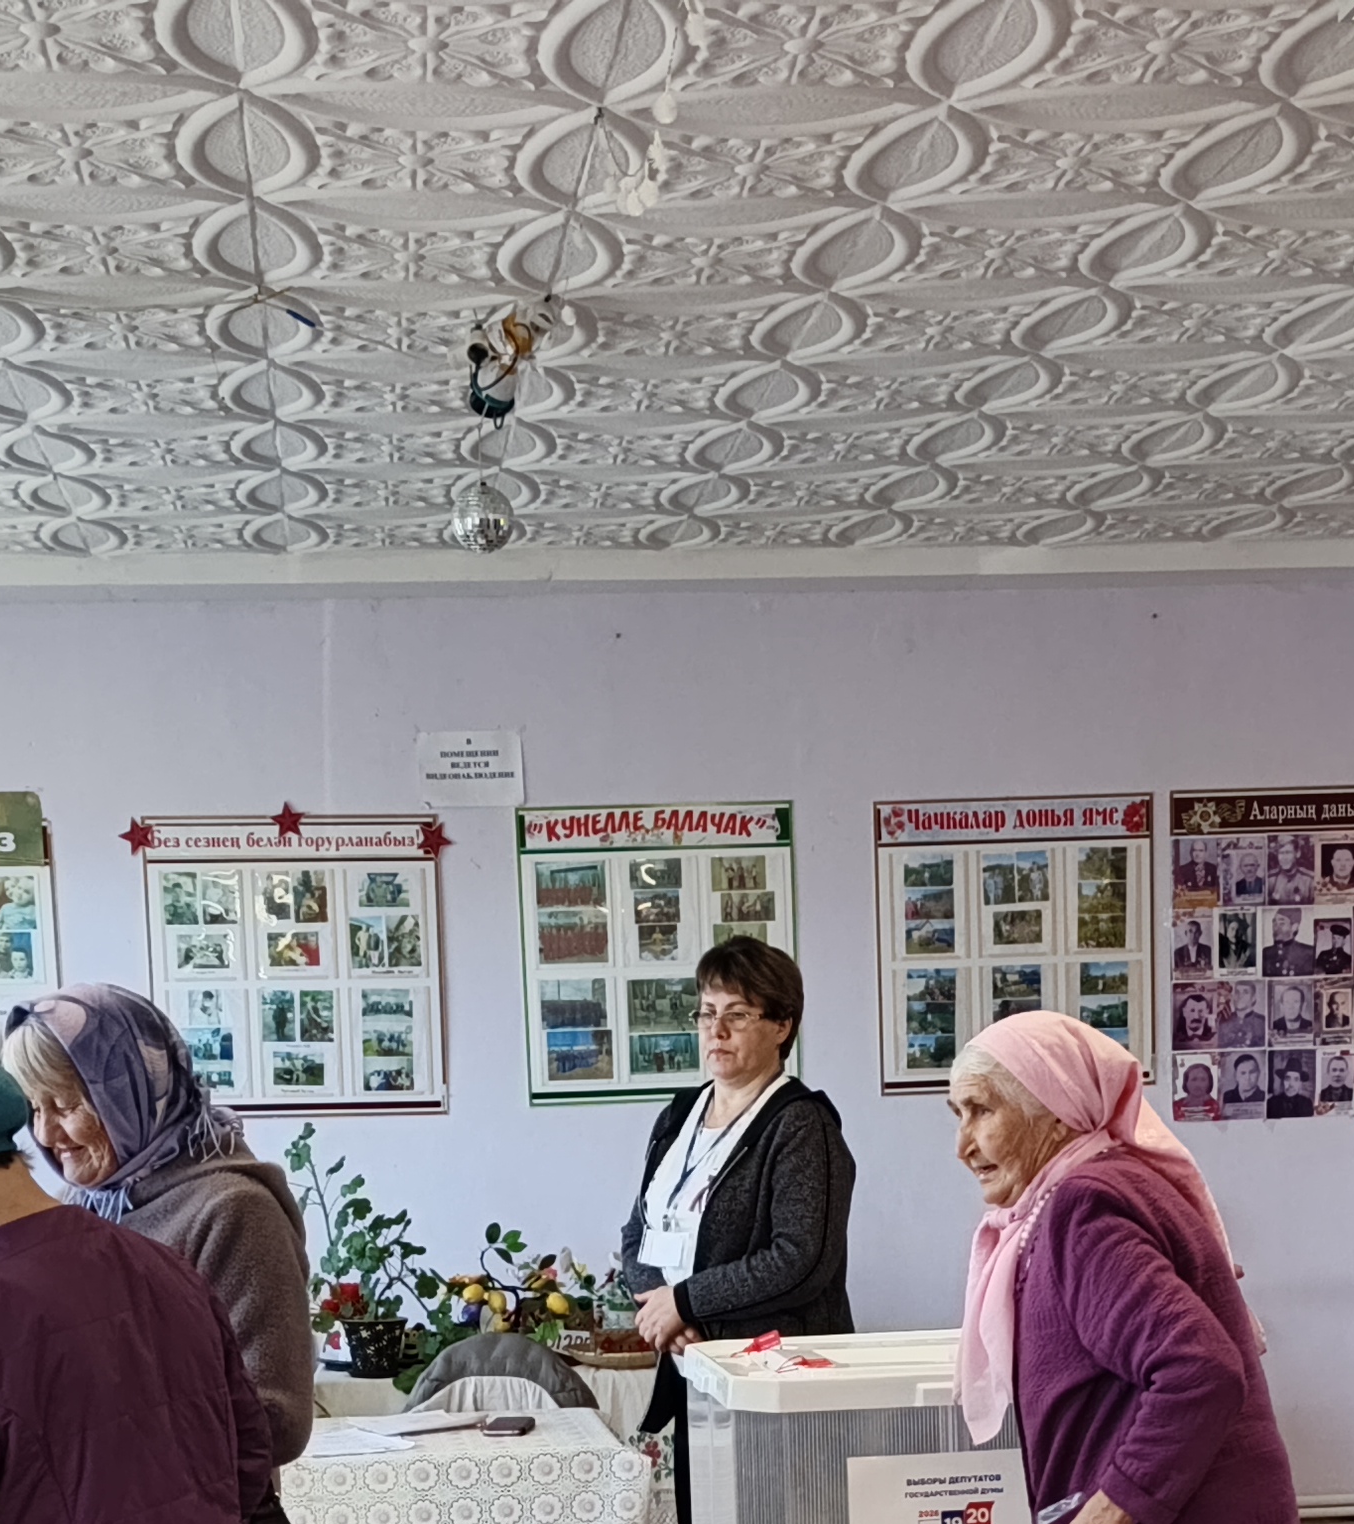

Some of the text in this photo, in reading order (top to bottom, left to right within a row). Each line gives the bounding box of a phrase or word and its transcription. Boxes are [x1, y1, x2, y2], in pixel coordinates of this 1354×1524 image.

[1081, 806, 1119, 827] яме
[1249, 800, 1317, 824] Аларның
[151, 829, 180, 849] Без
[906, 1474, 1001, 1486] ВЫБОРЫ ДЕПУТАТОВ
[980, 1487, 1004, 1495] ДУМЫ
[966, 1508, 989, 1523] 20
